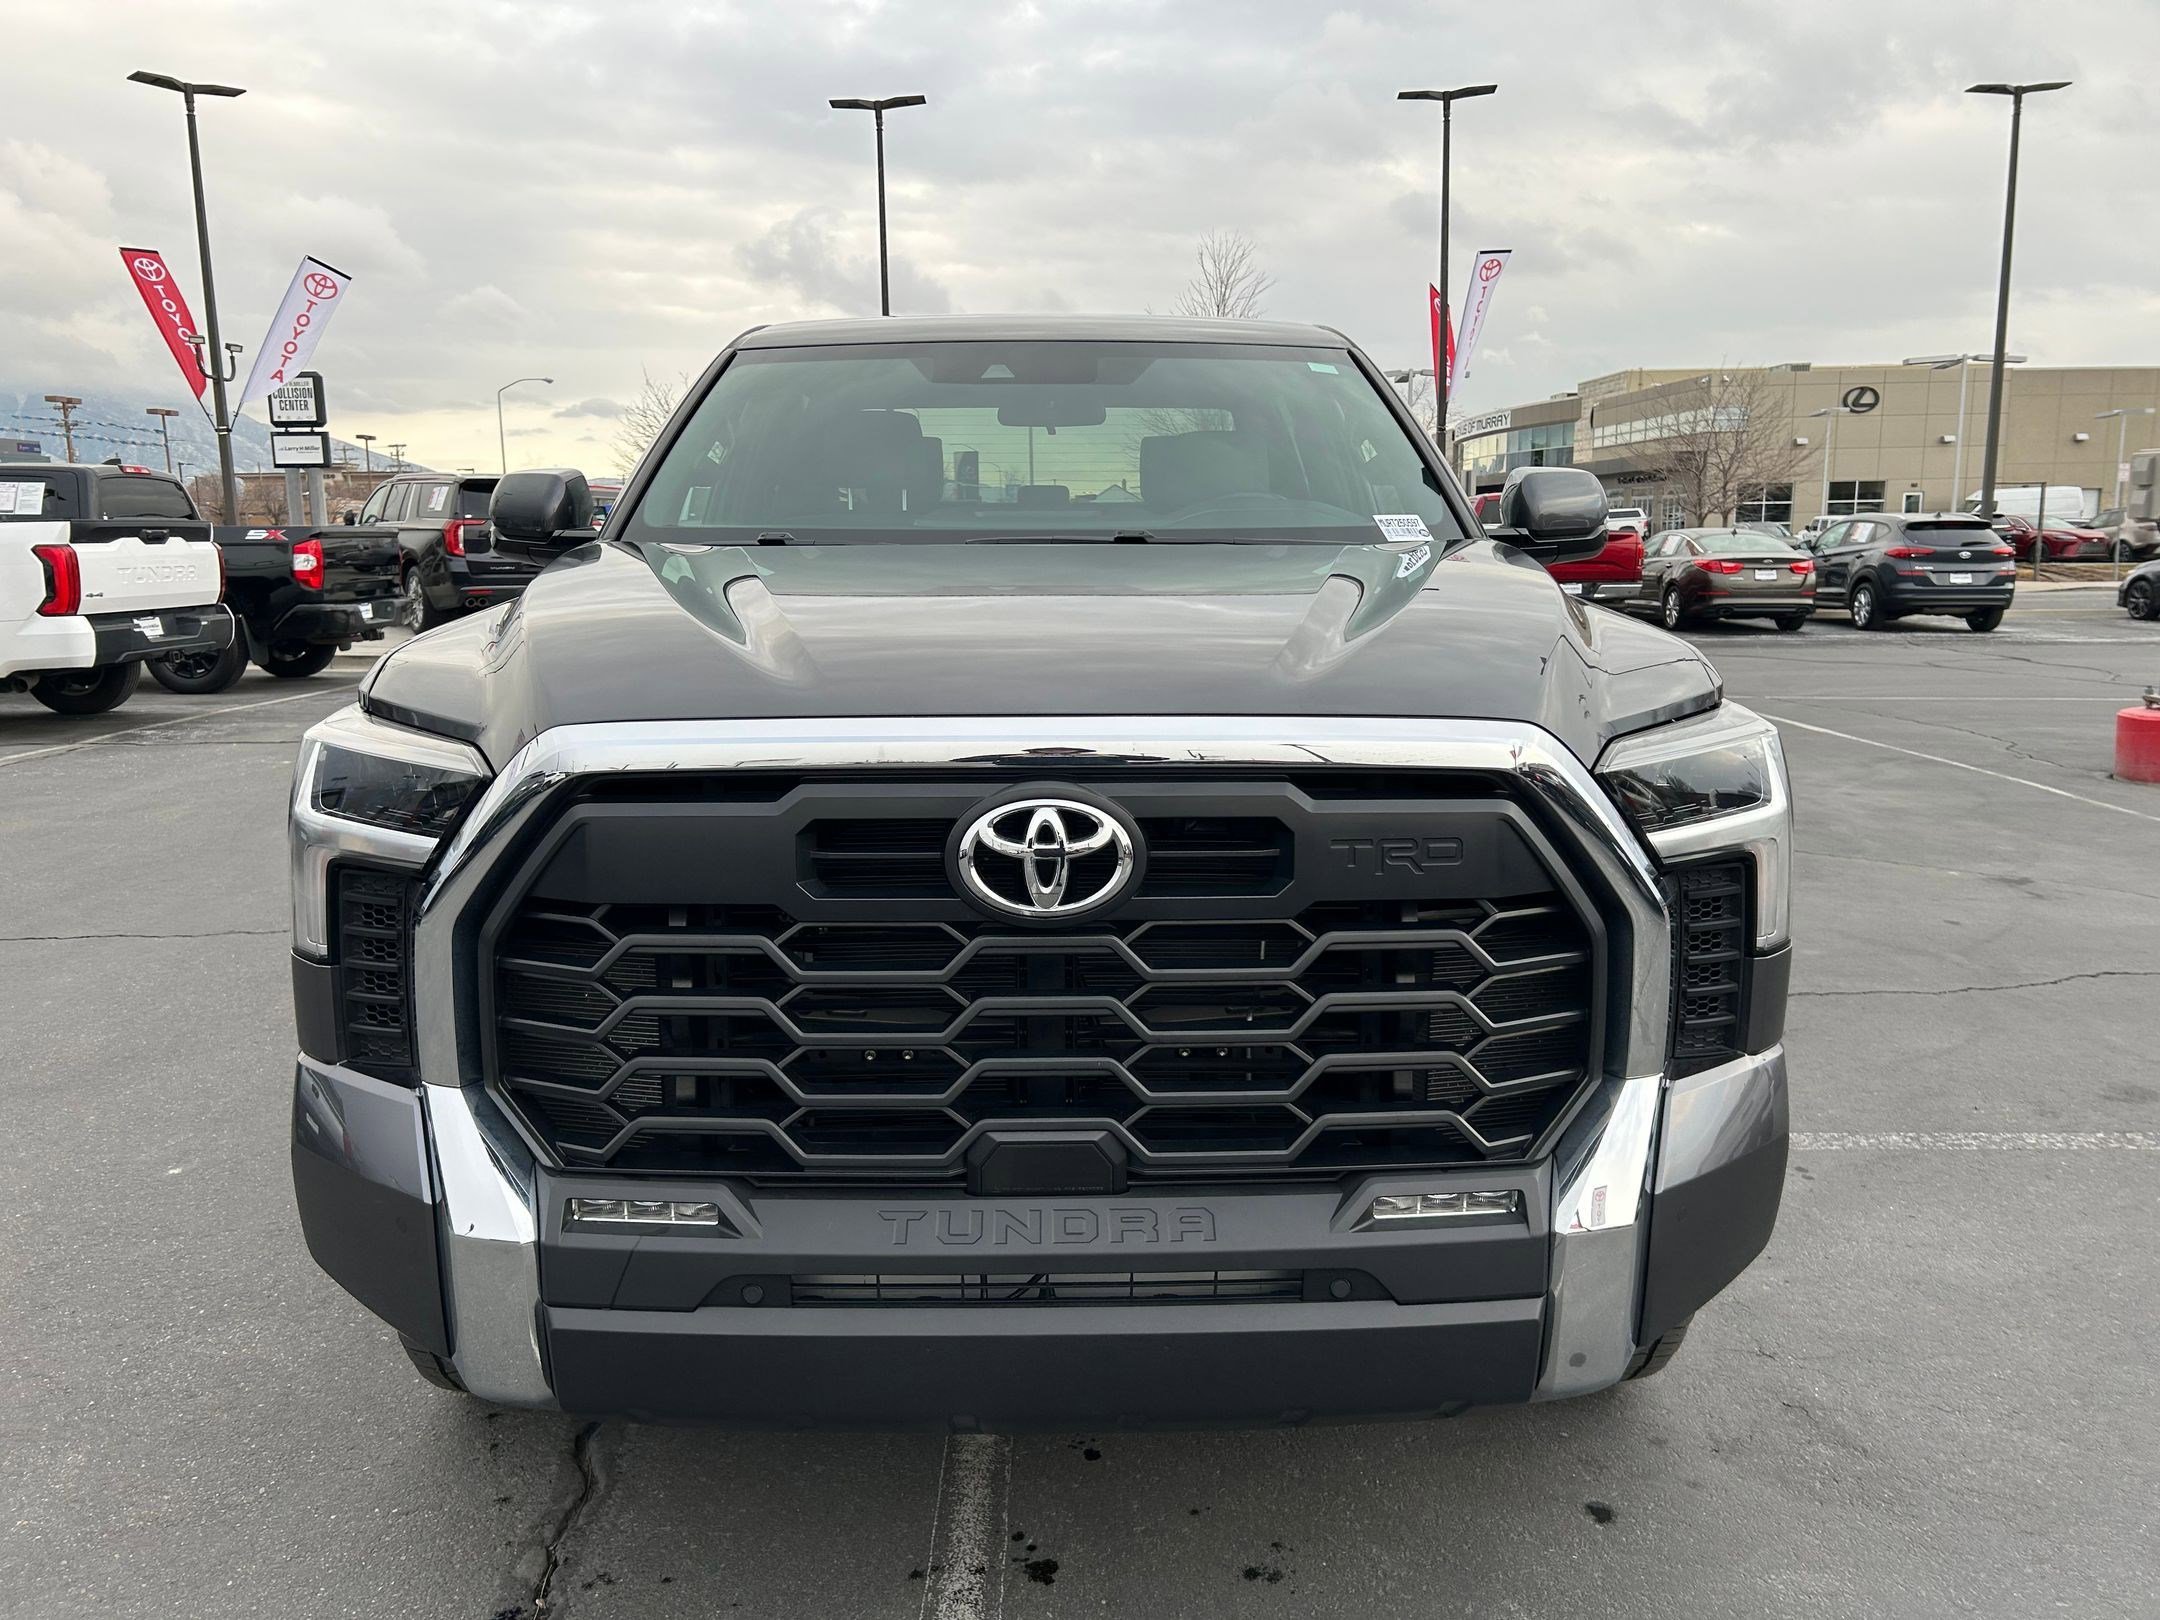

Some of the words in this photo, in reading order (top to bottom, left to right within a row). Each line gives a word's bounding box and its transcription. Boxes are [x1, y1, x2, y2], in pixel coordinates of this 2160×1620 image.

[153, 285, 205, 370] TOYOT
[270, 299, 318, 383] TOYOTA
[273, 387, 313, 399] COLLISION
[279, 400, 309, 411] CENTER
[1477, 414, 1510, 431] MURRAY
[117, 565, 198, 584] TUNDRA
[1330, 837, 1464, 876] TRD
[877, 1207, 1217, 1246] TUNDRA
